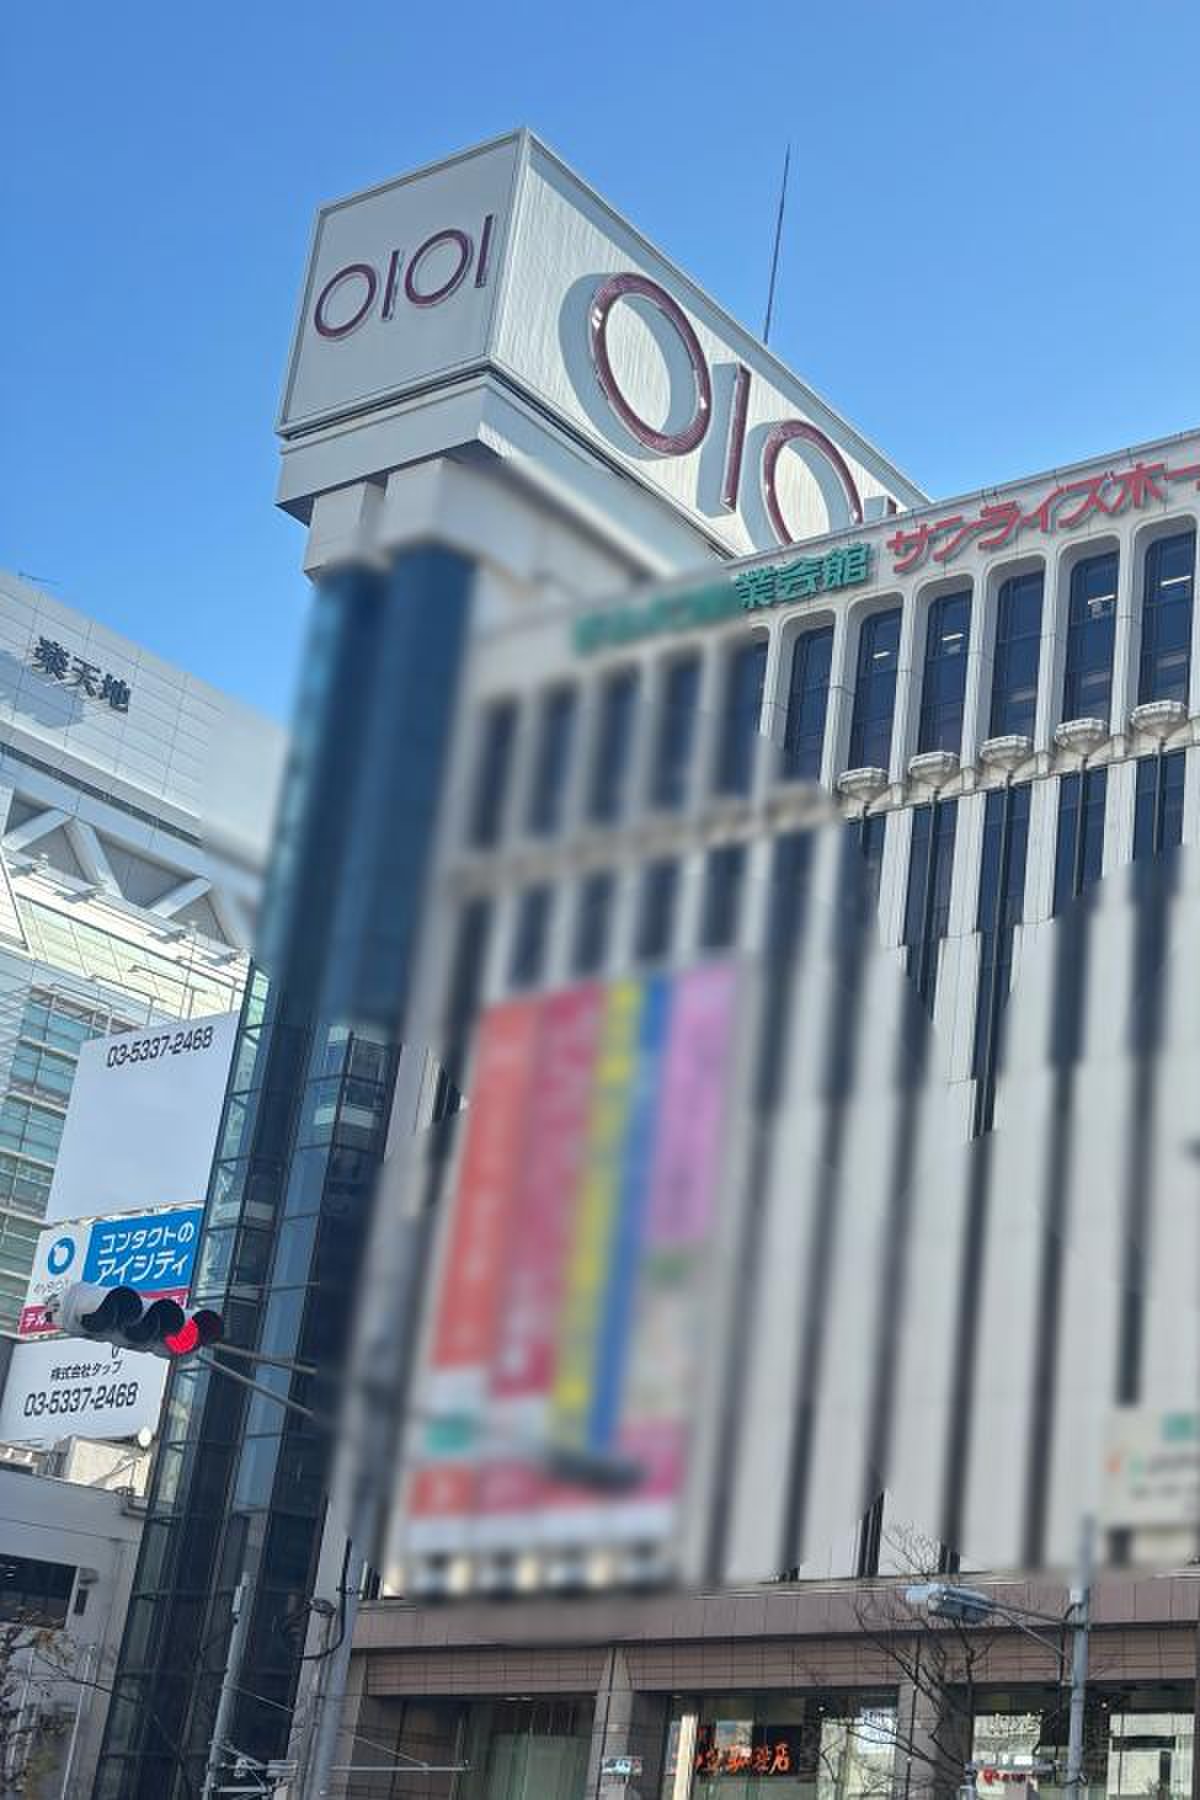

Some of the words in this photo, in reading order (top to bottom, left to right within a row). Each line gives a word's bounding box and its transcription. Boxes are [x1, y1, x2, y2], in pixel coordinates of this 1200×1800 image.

[106, 1025, 214, 1068] 03-5337-2468
[99, 1220, 195, 1255] コンタクトの
[95, 1249, 189, 1286] アイシティ
[50, 1359, 124, 1381] 株式会社タップ
[23, 1381, 139, 1418] 03-5337-2468
